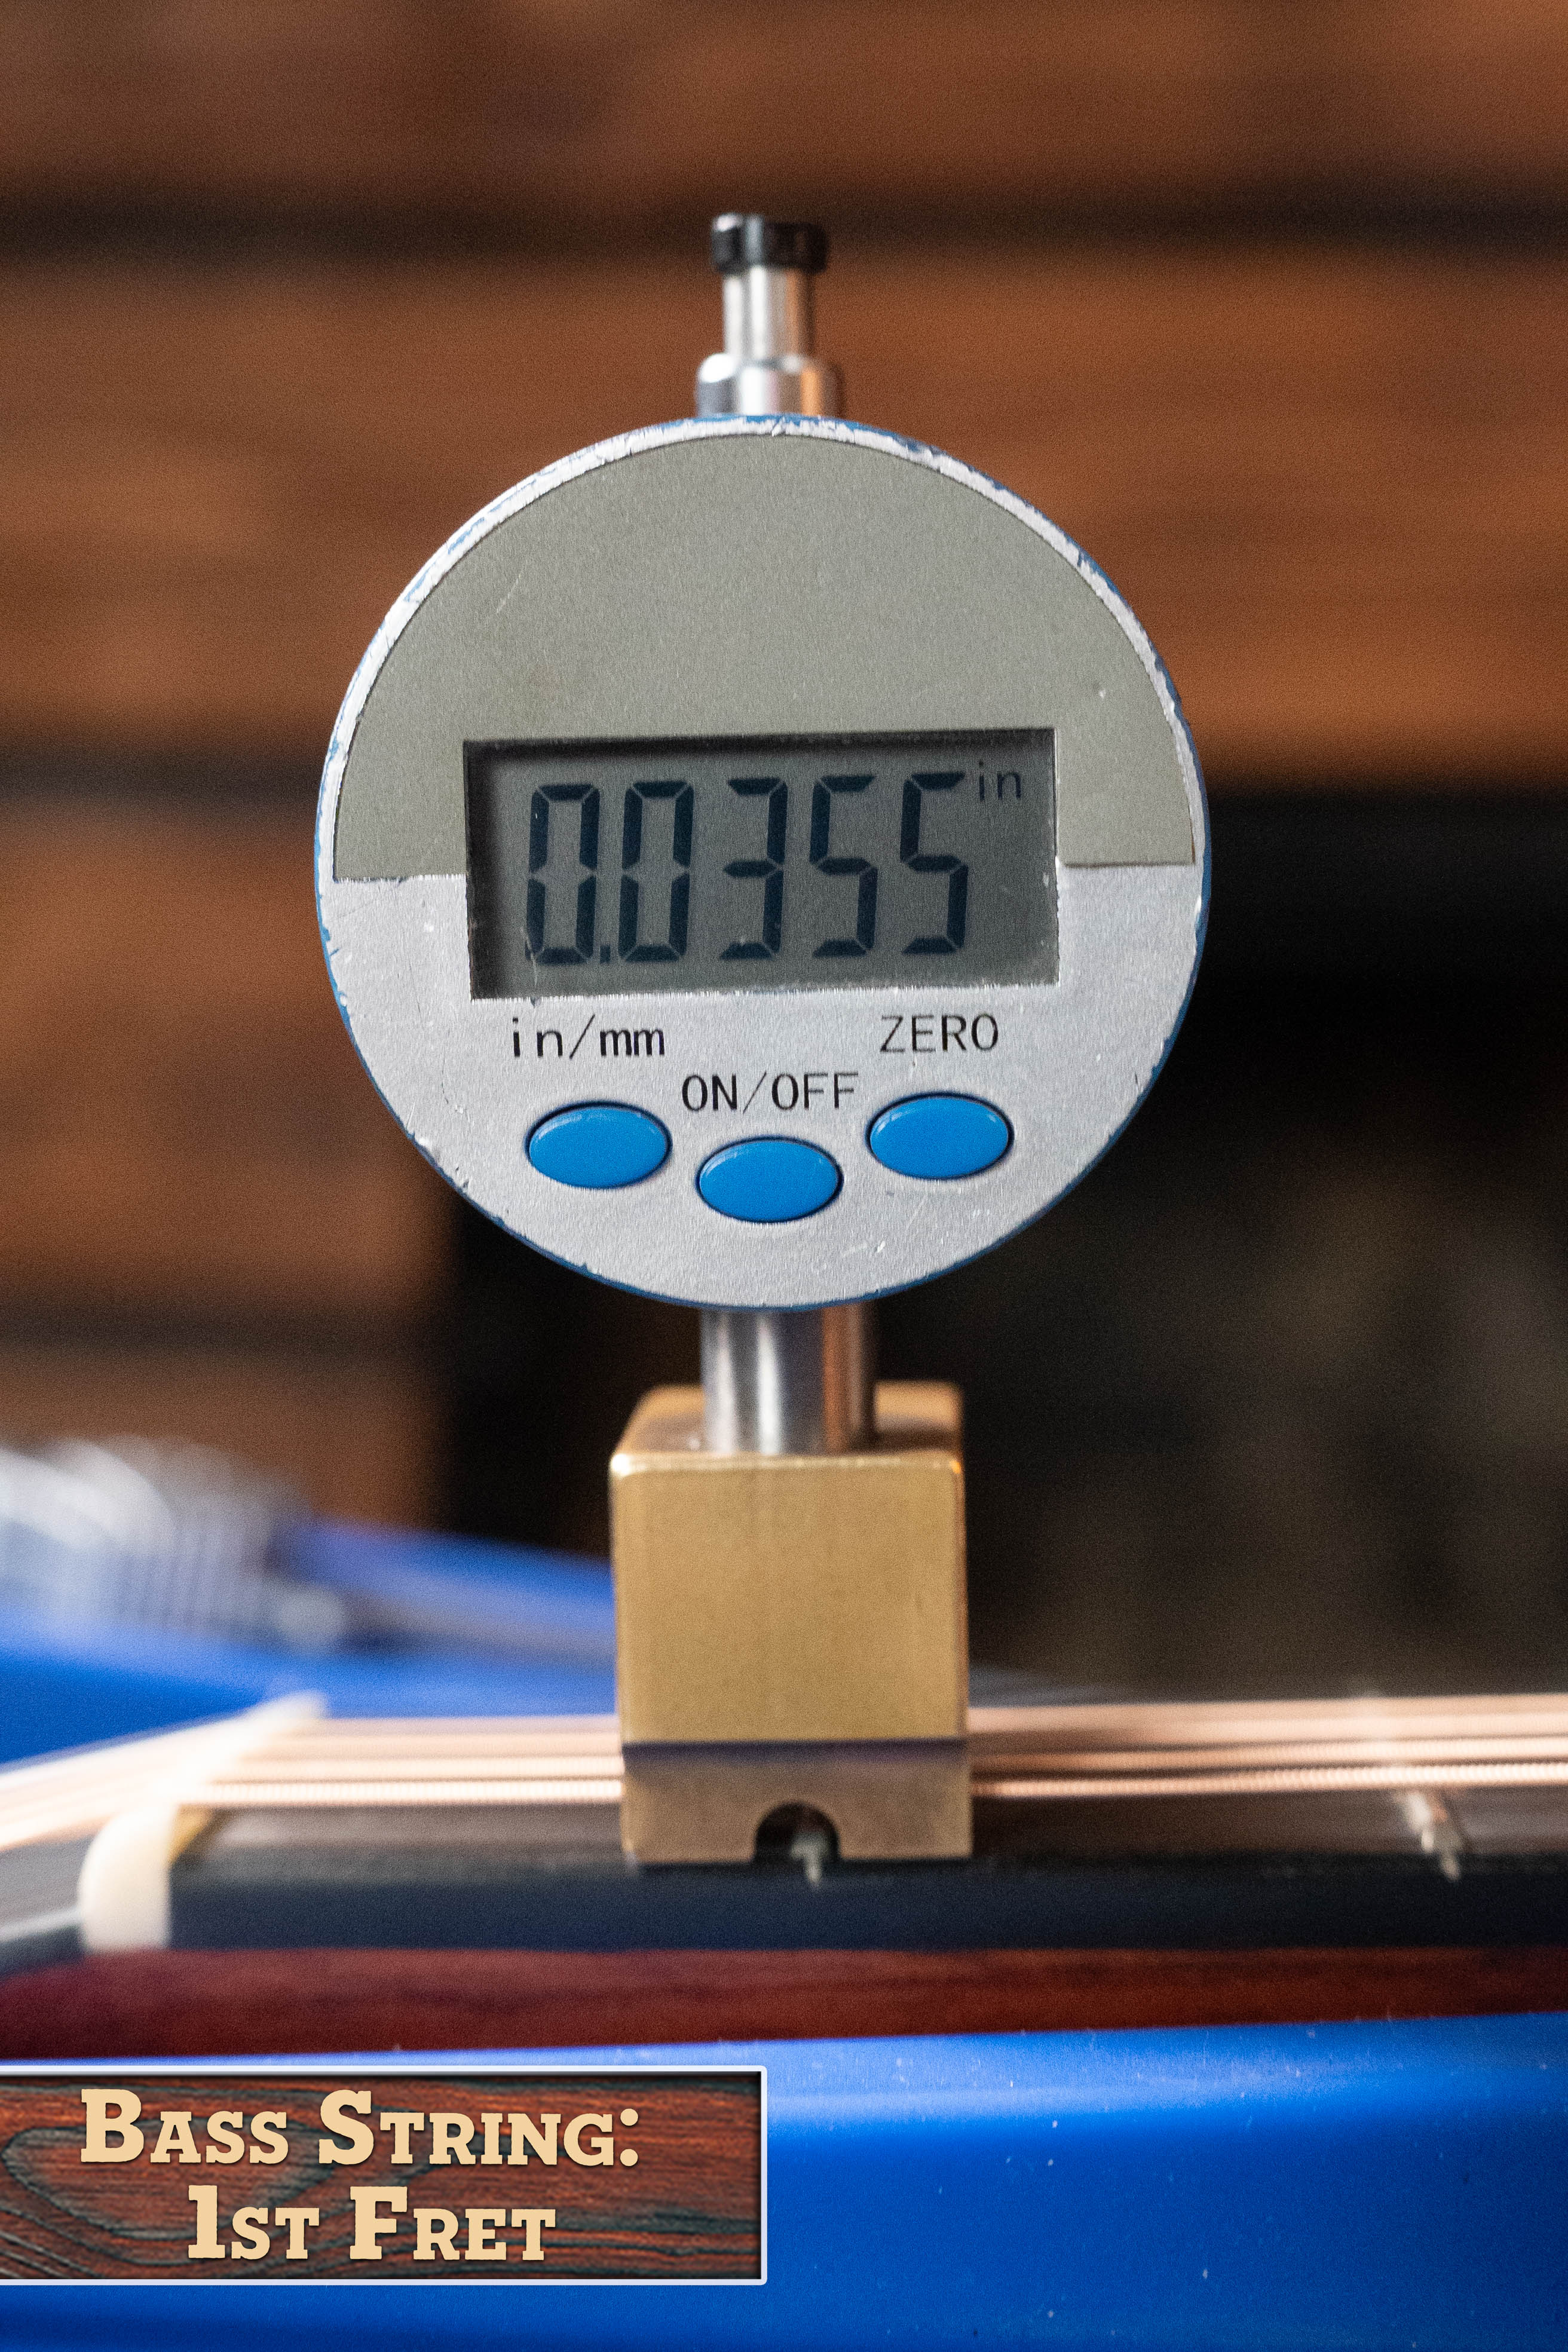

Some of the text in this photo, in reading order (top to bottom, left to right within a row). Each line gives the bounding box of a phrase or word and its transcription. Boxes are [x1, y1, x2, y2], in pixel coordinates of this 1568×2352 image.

[526, 760, 1022, 965] 0.0355 in
[512, 1015, 666, 1058] in/mm
[880, 1013, 1000, 1054] ZERO
[682, 1072, 859, 1114] ON/OFF
